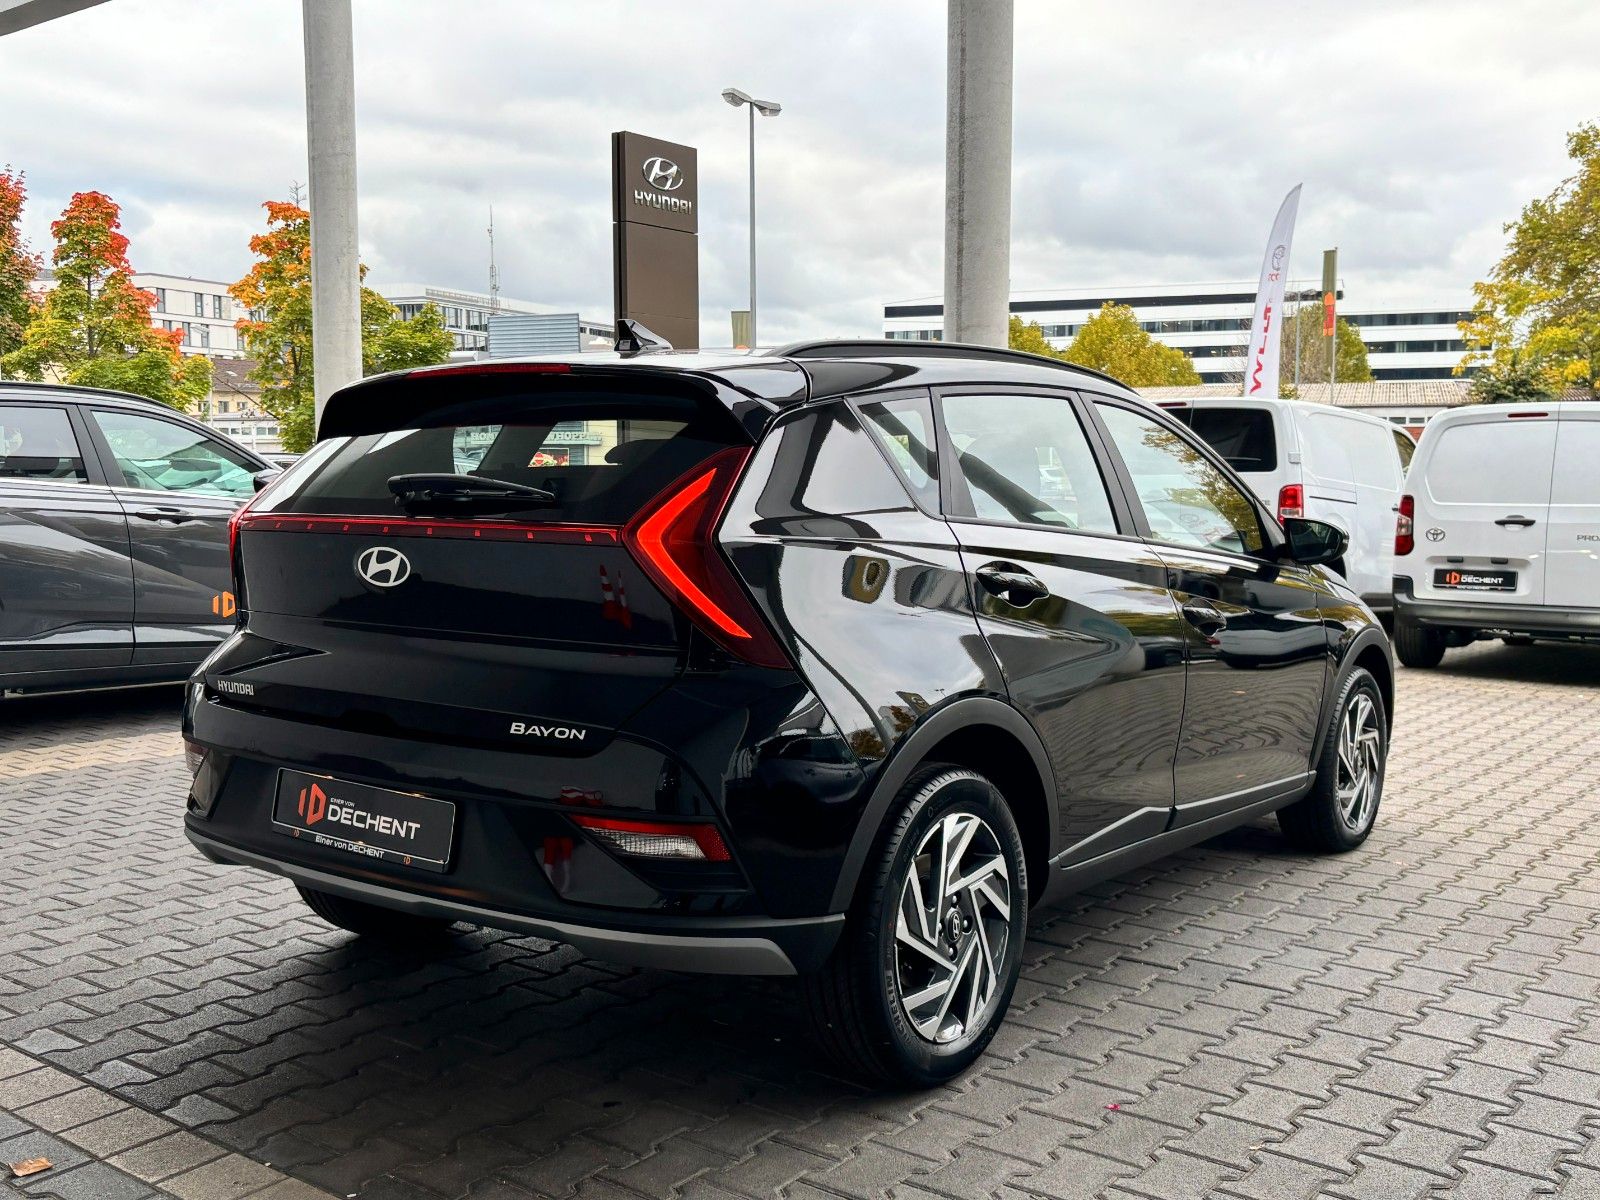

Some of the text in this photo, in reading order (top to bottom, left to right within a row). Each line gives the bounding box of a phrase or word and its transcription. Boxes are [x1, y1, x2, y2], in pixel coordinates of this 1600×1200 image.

[634, 189, 692, 215] HYUNDAI
[1576, 534, 1600, 542] PRO
[1460, 575, 1504, 585] DECHENT
[217, 679, 254, 696] HYUNDAI
[510, 722, 586, 740] BAYON
[328, 804, 420, 839] DECHENT
[315, 835, 384, 859] Einer von DECHENT
